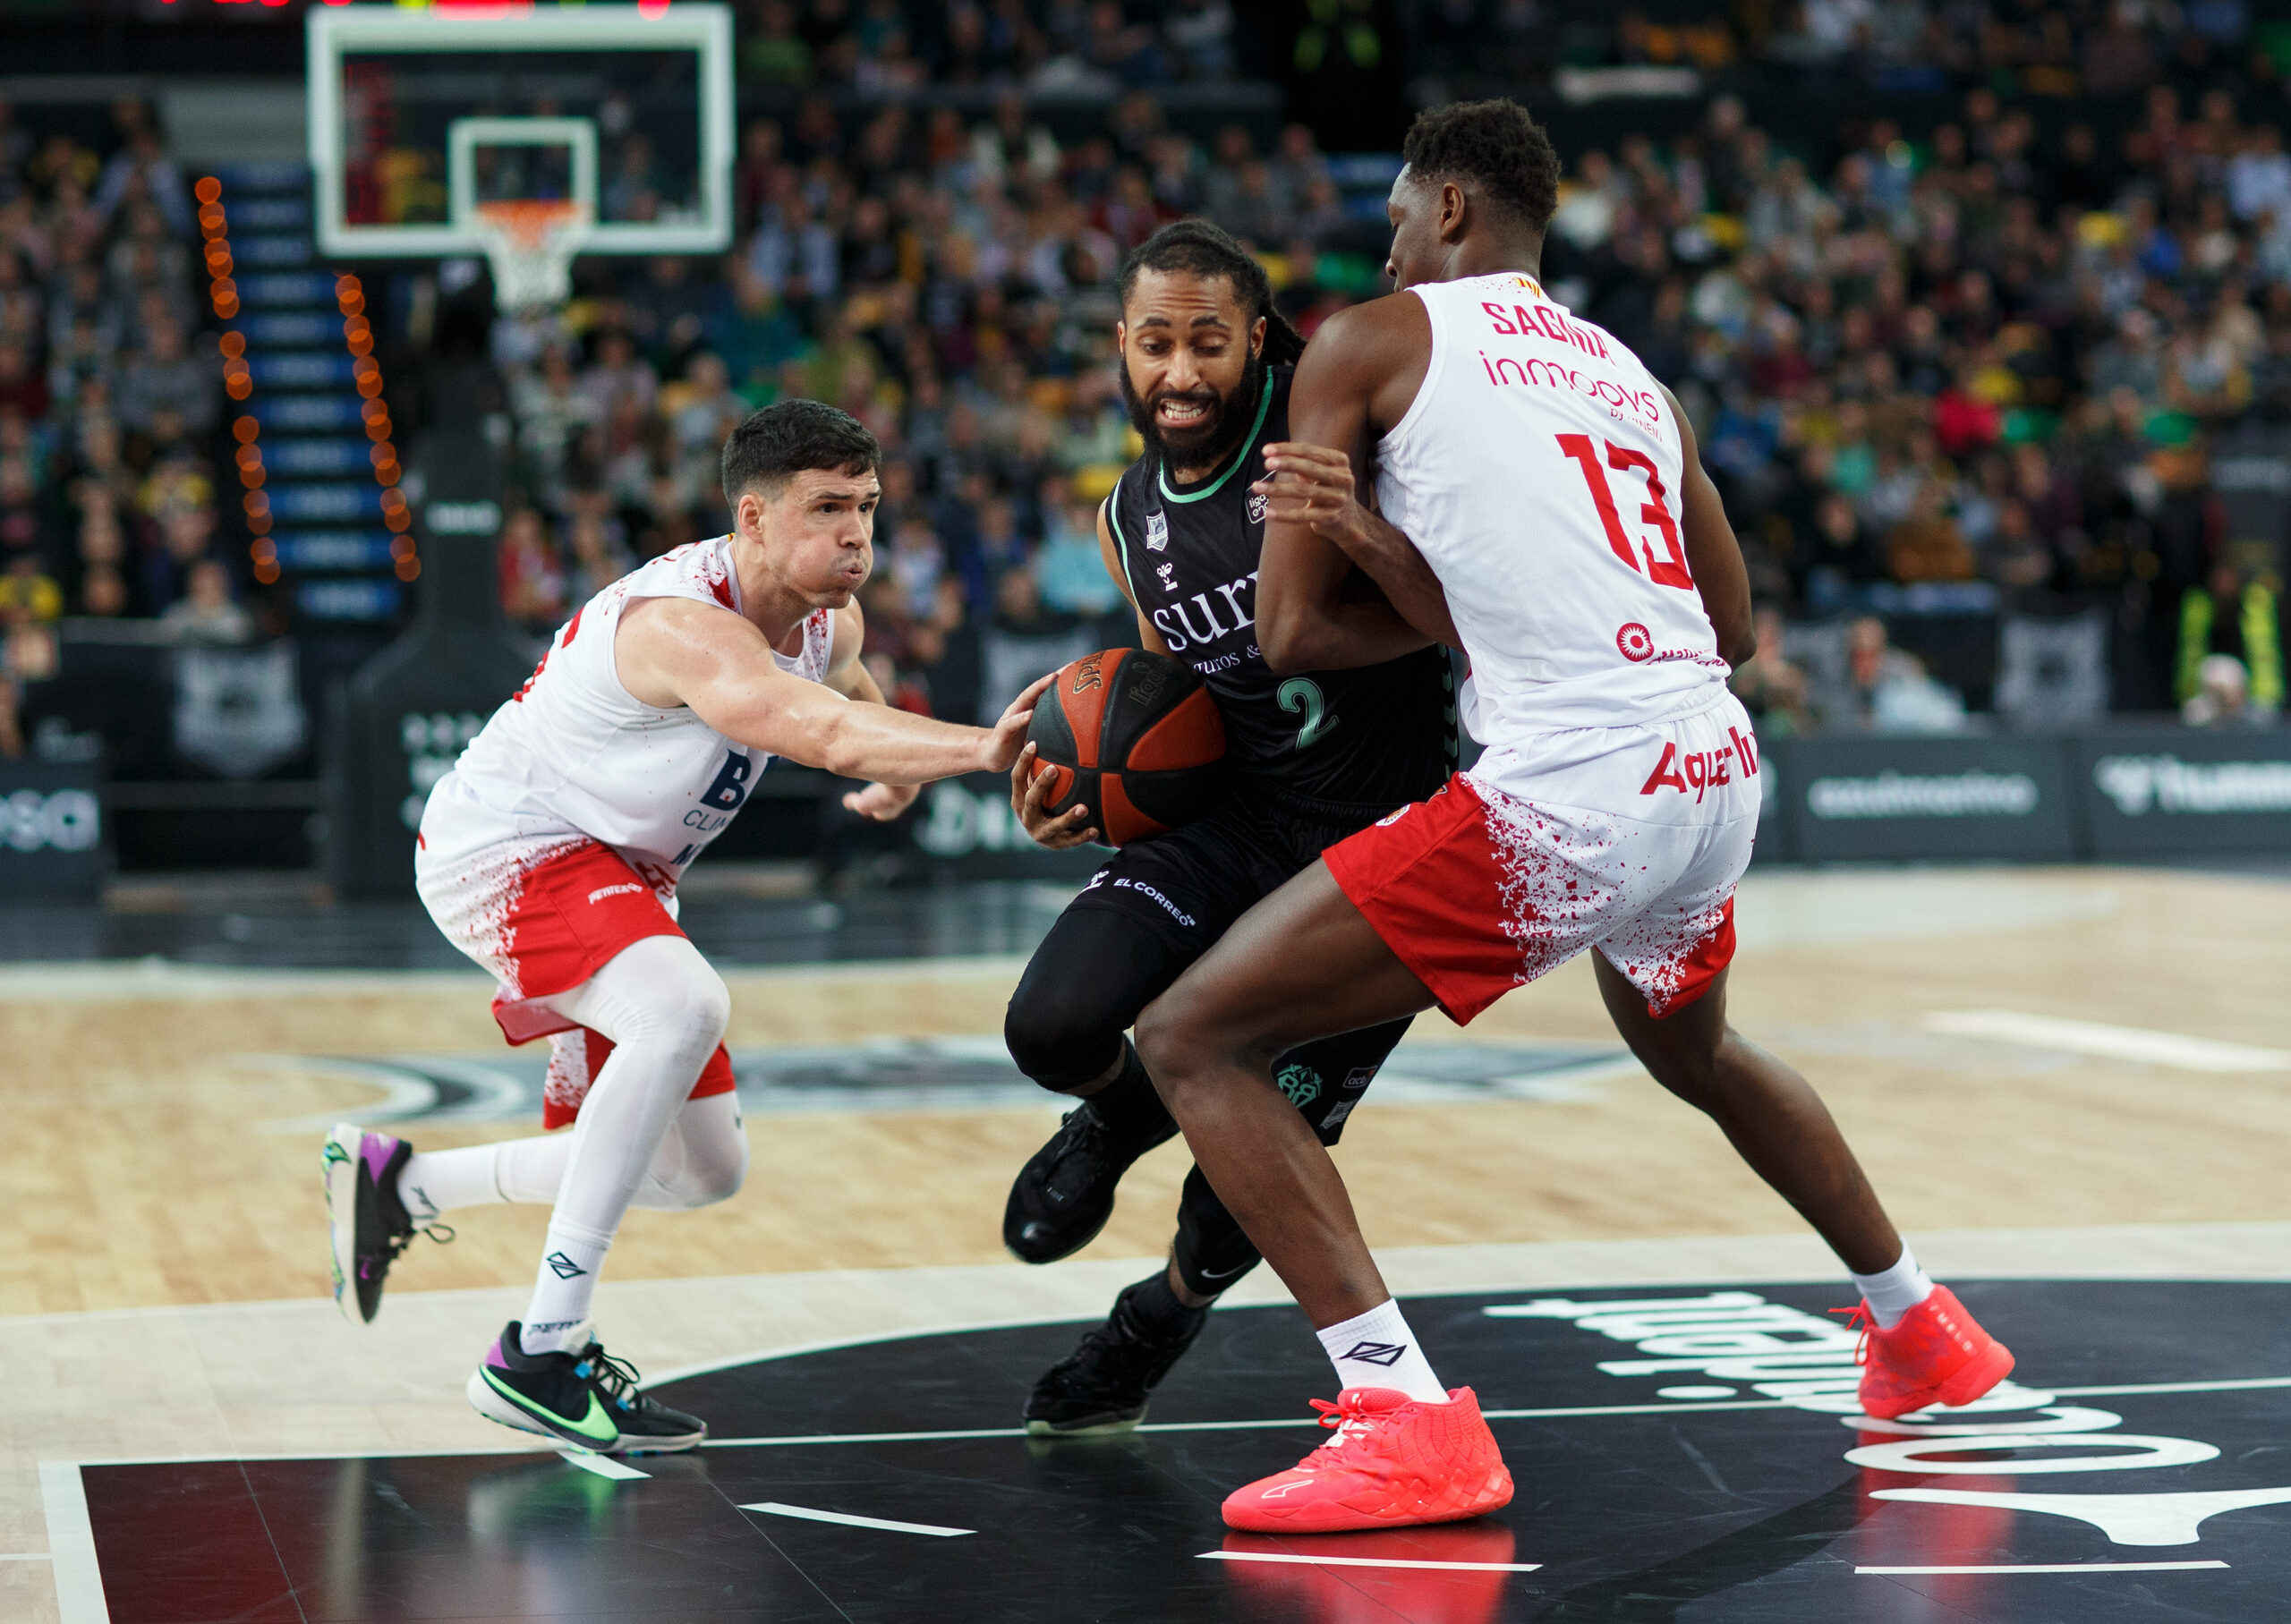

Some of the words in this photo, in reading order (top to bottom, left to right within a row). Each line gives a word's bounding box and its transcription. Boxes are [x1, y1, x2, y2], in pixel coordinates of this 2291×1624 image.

[1554, 433, 1694, 591] 13
[1277, 677, 1339, 752] 2
[1113, 878, 1131, 888] EL
[1134, 881, 1188, 926] CORREO
